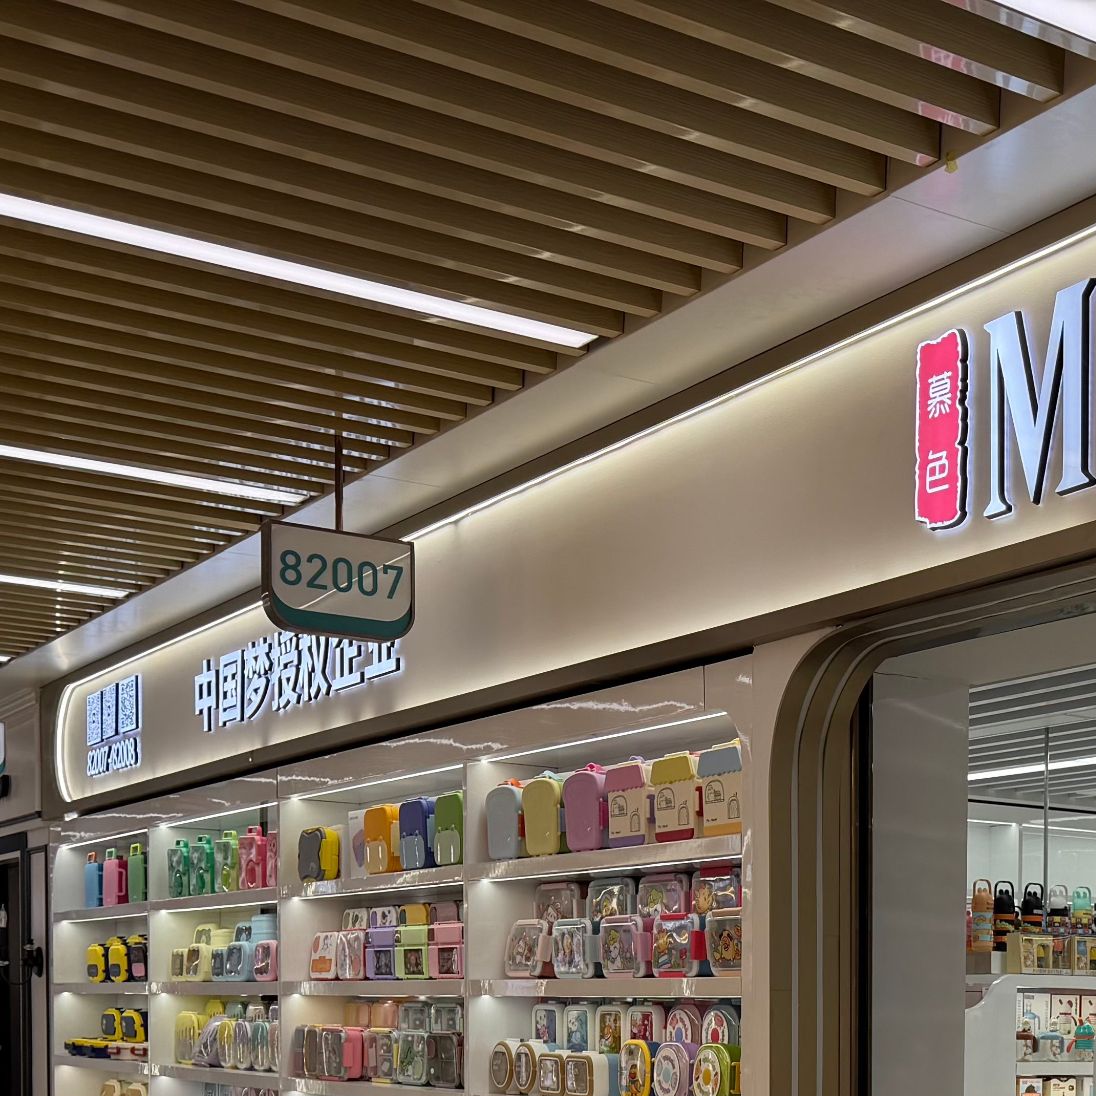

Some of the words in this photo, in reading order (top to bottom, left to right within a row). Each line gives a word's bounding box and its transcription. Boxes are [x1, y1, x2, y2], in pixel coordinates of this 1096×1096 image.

[926, 371, 952, 494] 慕色
[279, 549, 404, 600] 82007
[194, 631, 403, 732] 中国梦授权企业
